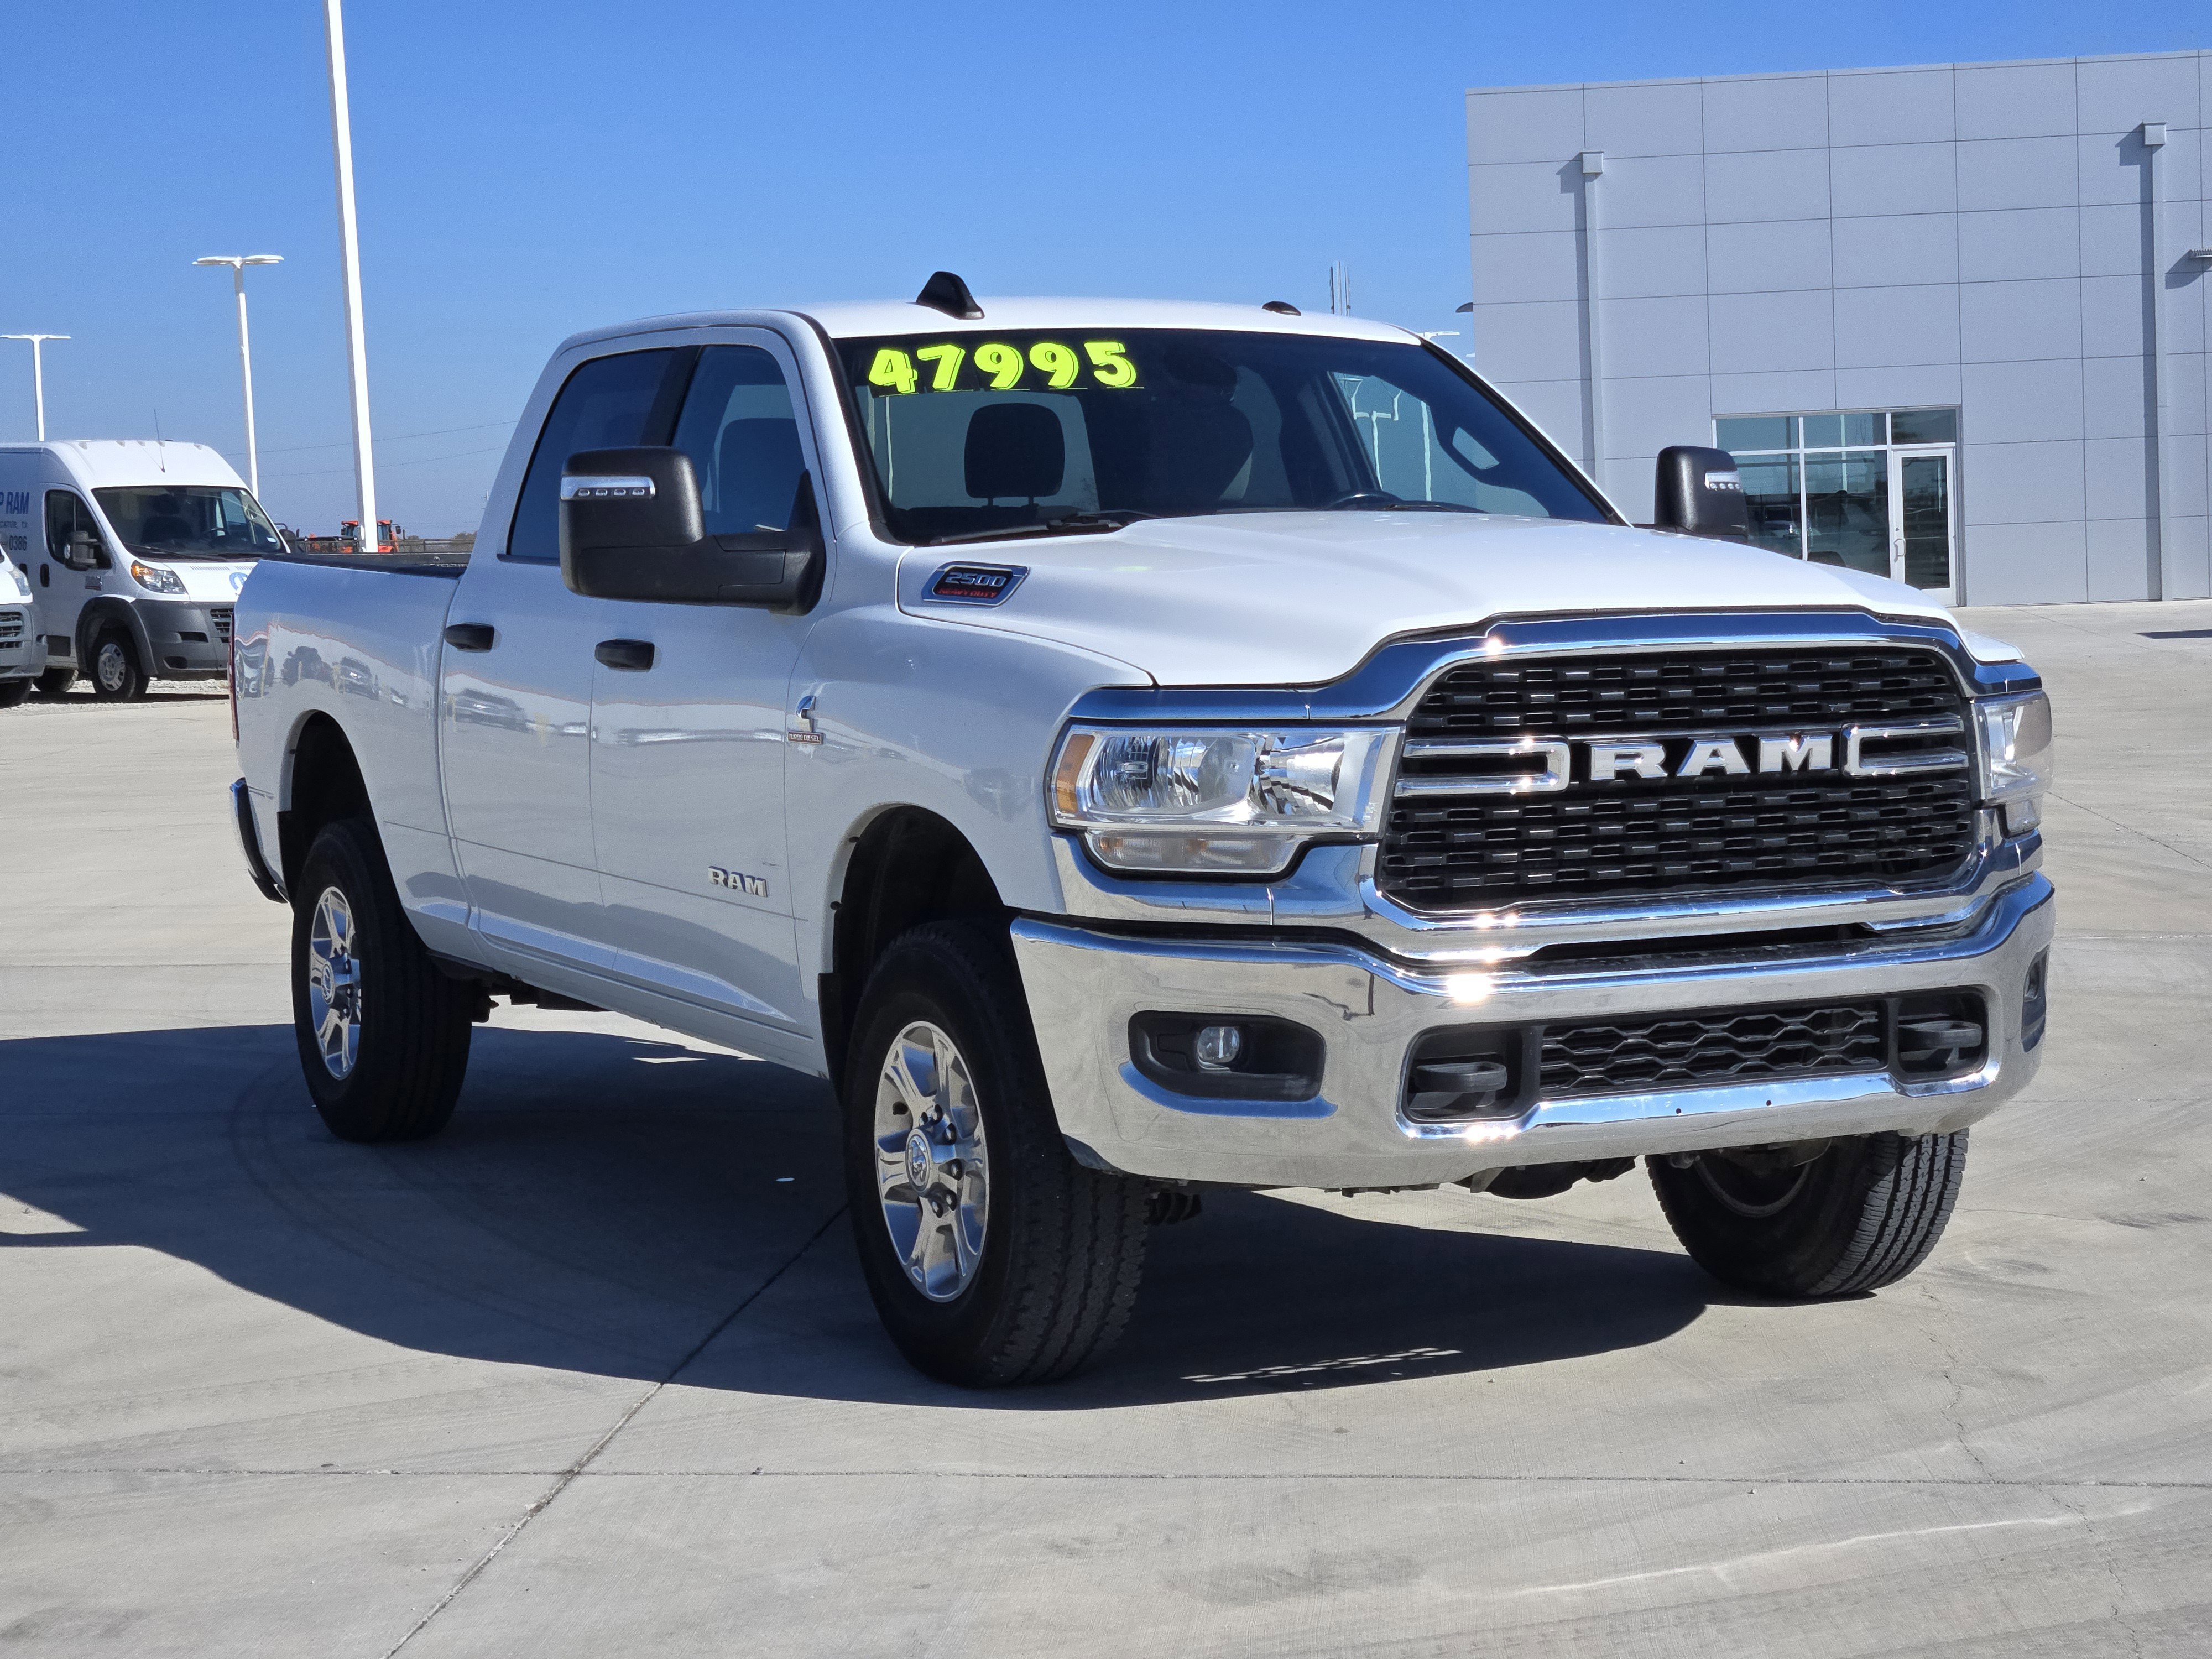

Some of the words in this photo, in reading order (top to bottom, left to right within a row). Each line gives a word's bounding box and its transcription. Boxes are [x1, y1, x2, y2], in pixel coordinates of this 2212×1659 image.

[868, 342, 1136, 393] 47995
[6, 491, 29, 514] RAM
[945, 572, 1007, 587] 2500
[1589, 734, 1833, 781] RAM
[708, 865, 768, 898] RAM
